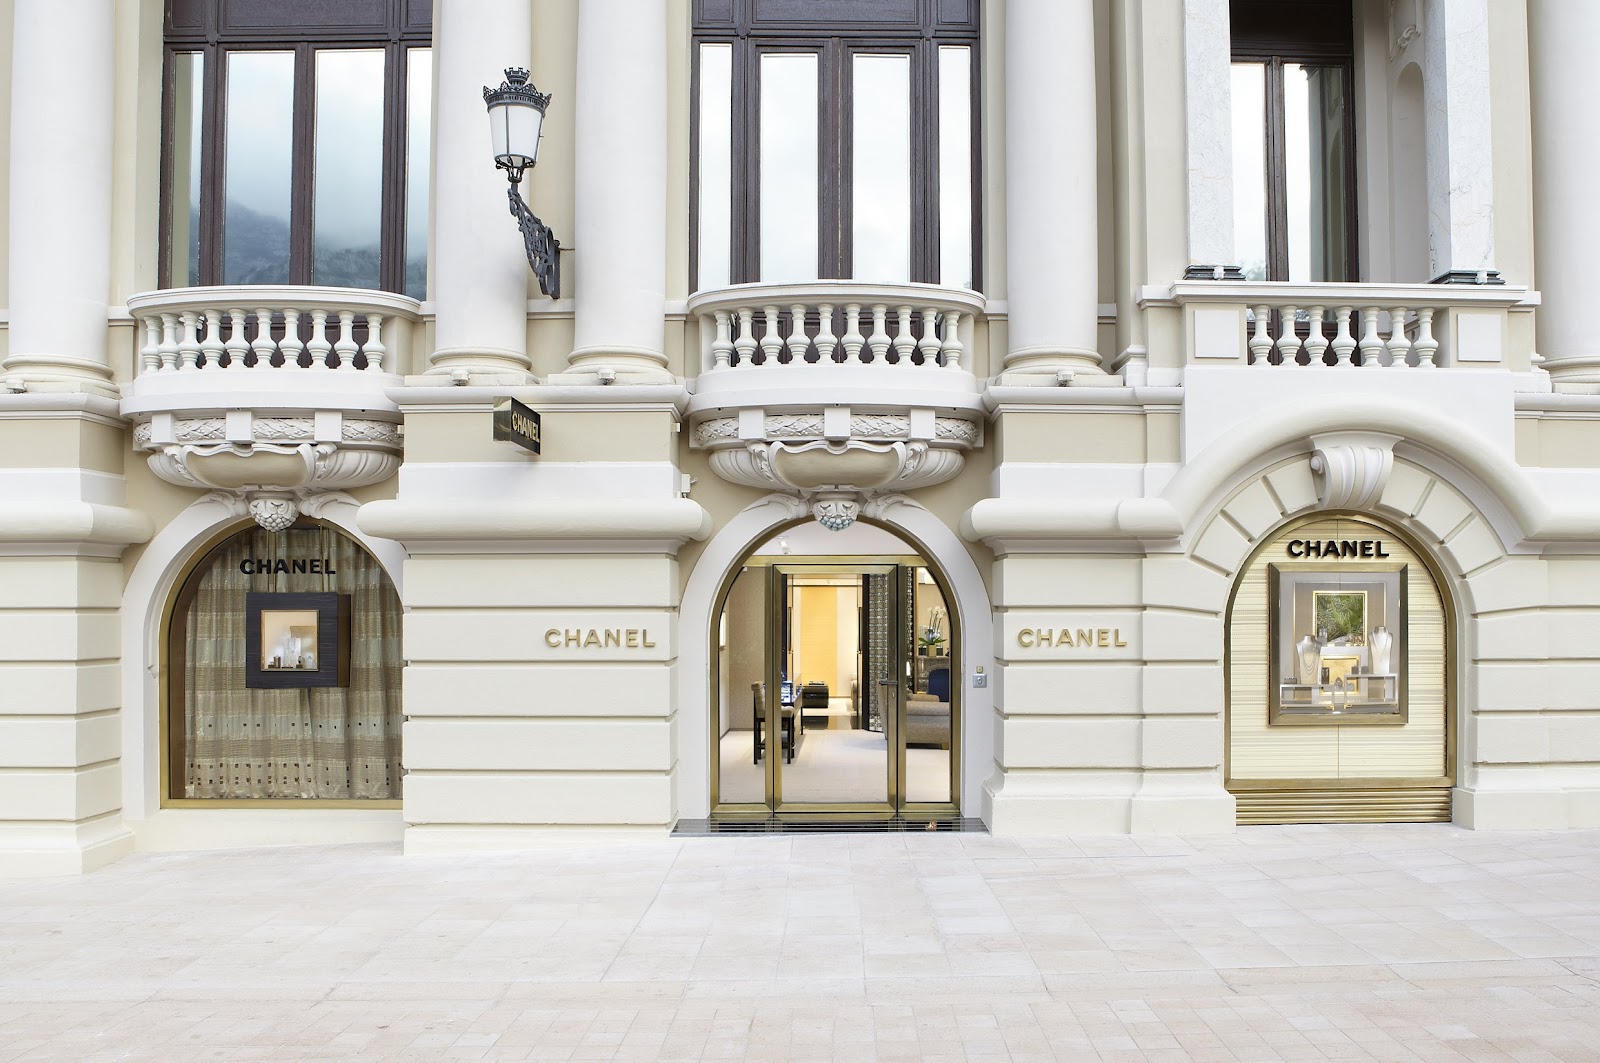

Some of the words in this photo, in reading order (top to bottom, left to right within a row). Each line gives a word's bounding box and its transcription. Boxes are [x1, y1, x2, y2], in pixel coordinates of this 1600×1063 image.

[511, 410, 540, 443] CHANEL
[1287, 539, 1390, 557] CHANEL
[239, 559, 336, 575] CHANEL
[544, 628, 656, 648] CHANEL
[1017, 628, 1128, 648] CHANEL
